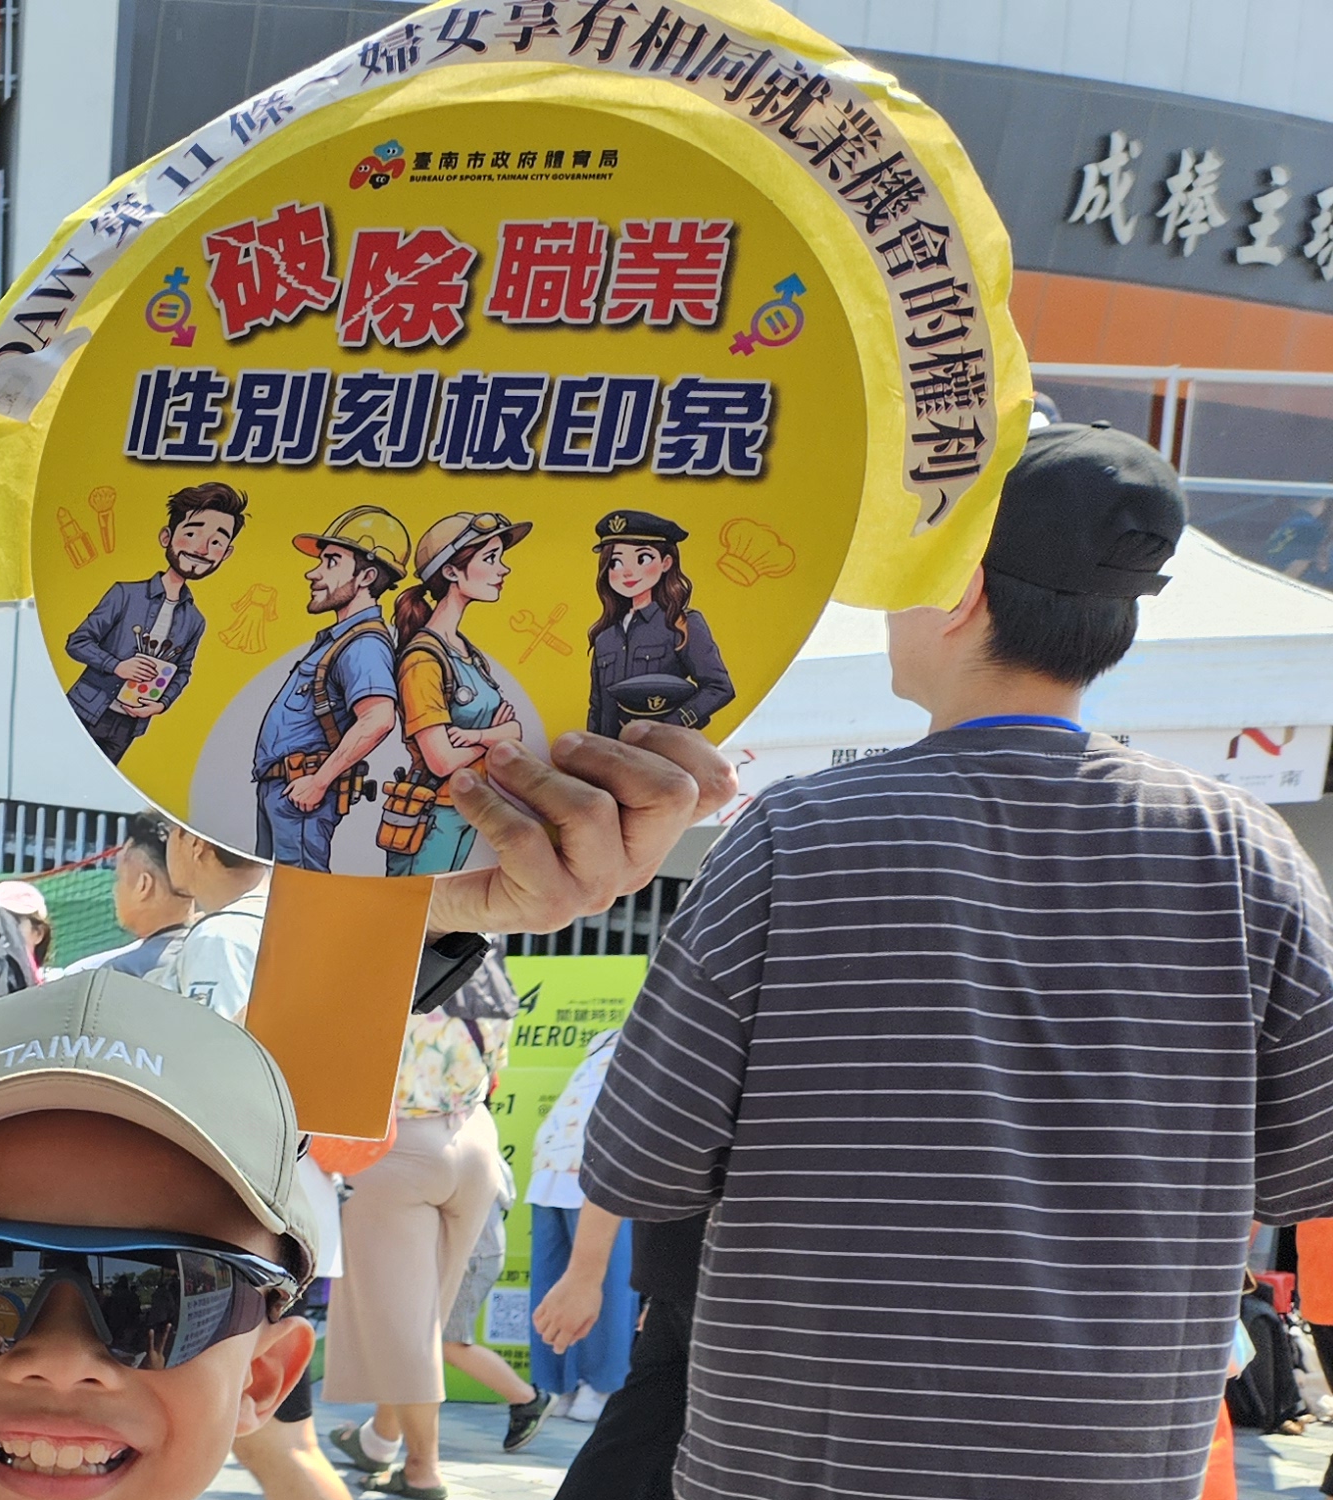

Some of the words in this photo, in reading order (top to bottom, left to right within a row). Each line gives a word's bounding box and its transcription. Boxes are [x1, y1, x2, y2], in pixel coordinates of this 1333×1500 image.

[409, 175, 445, 183] BUREAU
[446, 174, 458, 182] OF
[497, 173, 528, 181] TAINAN
[530, 173, 550, 181] CITY
[551, 172, 613, 181] GOVERNMENT
[123, 367, 773, 478] 性別刻板印象
